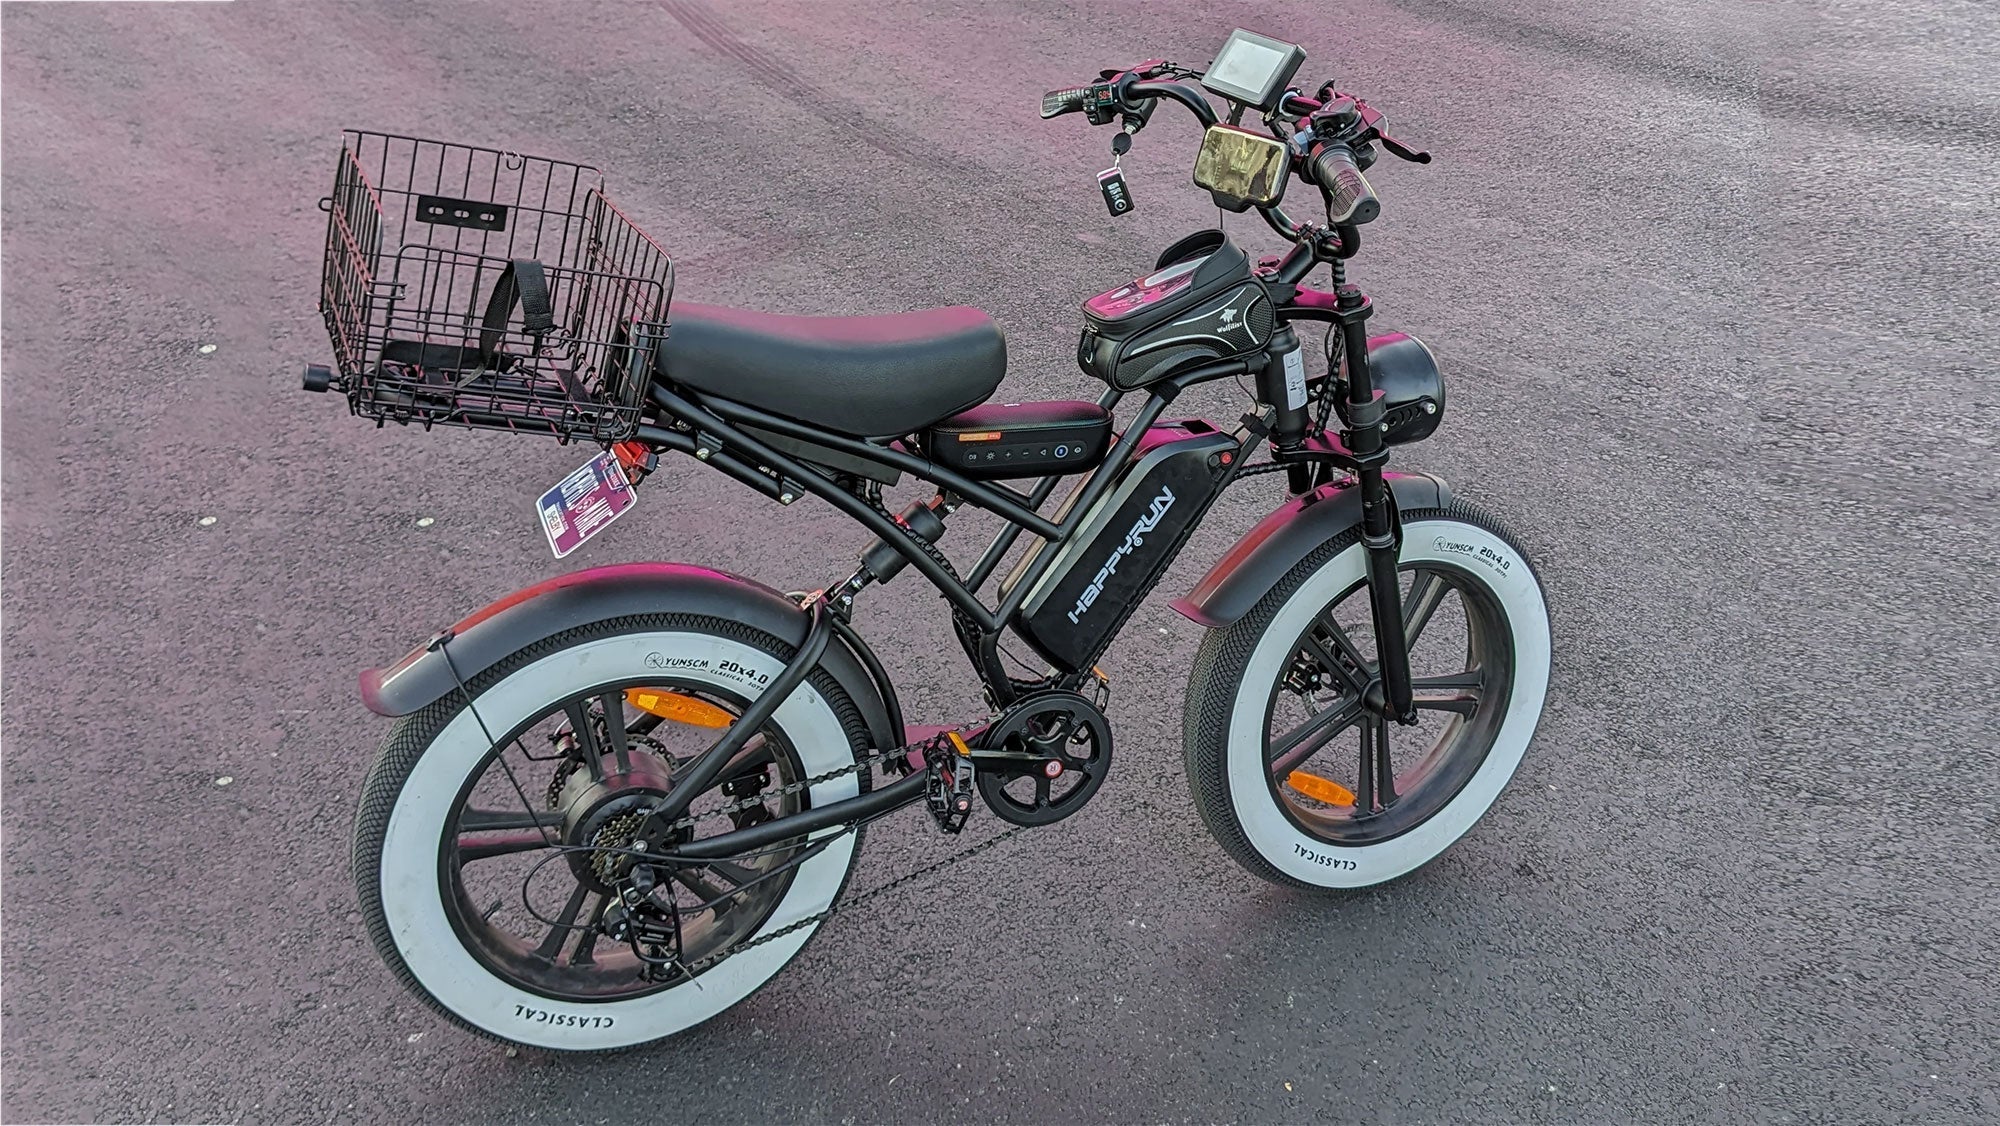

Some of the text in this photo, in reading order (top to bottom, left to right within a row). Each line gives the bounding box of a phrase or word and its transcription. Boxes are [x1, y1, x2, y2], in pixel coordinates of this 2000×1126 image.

[1445, 542, 1511, 570] YUNSCM 20x4.0
[665, 657, 769, 685] YUNSCM 20x4.0
[1294, 843, 1357, 871] CLASSICAL
[515, 1004, 614, 1029] CLASSICAL
